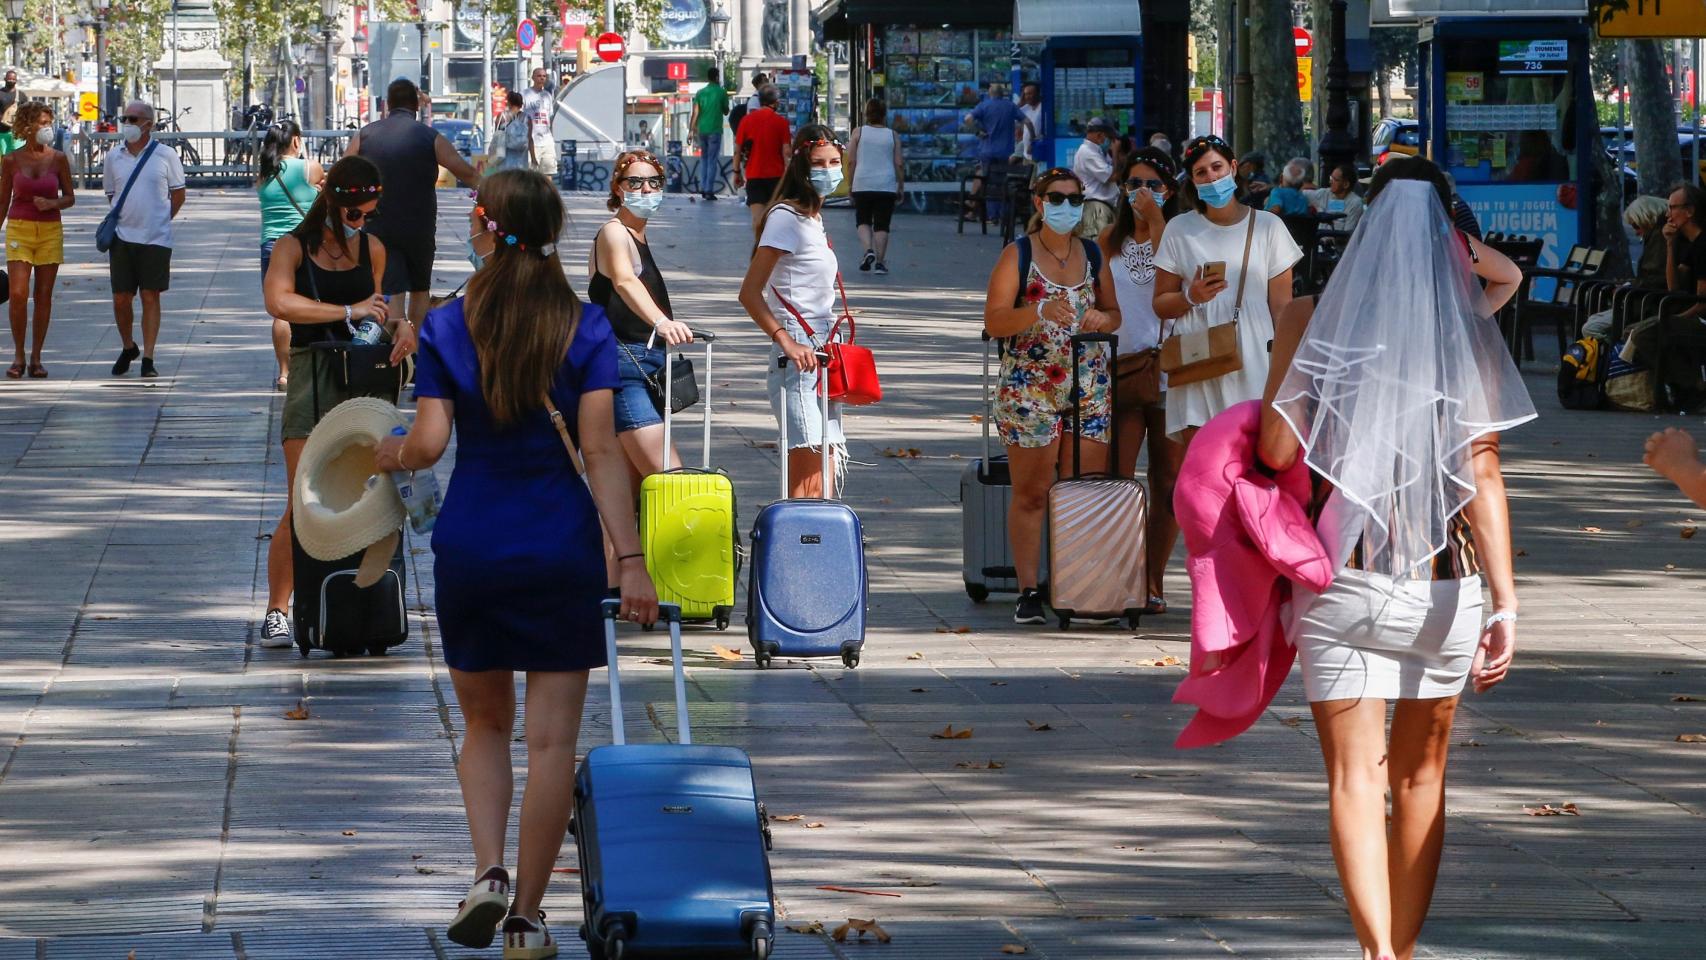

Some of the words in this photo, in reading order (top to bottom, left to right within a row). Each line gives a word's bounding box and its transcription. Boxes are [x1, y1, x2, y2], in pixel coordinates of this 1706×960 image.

[1524, 61, 1543, 70] 736
[1466, 76, 1480, 89] 59
[1489, 212, 1558, 231] JUGUEM
